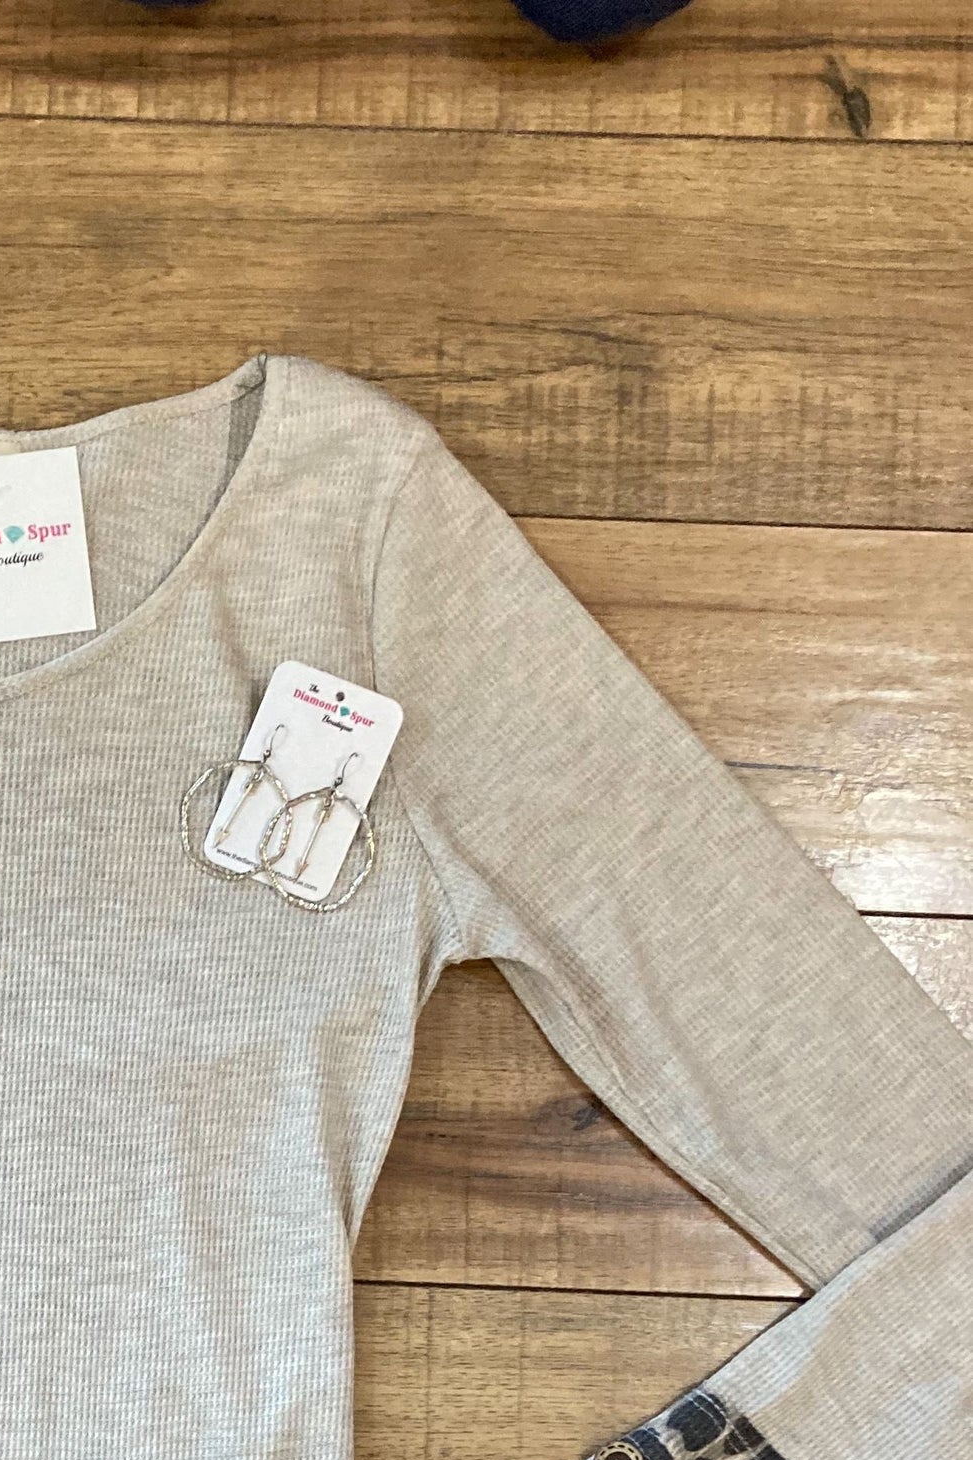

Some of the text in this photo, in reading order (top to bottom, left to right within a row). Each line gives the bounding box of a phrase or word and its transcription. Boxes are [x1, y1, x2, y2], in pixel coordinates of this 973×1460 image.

[27, 522, 72, 543] Spur
[309, 683, 320, 694] The
[293, 688, 375, 728] Diamond Spur
[322, 714, 354, 733] Boutique
